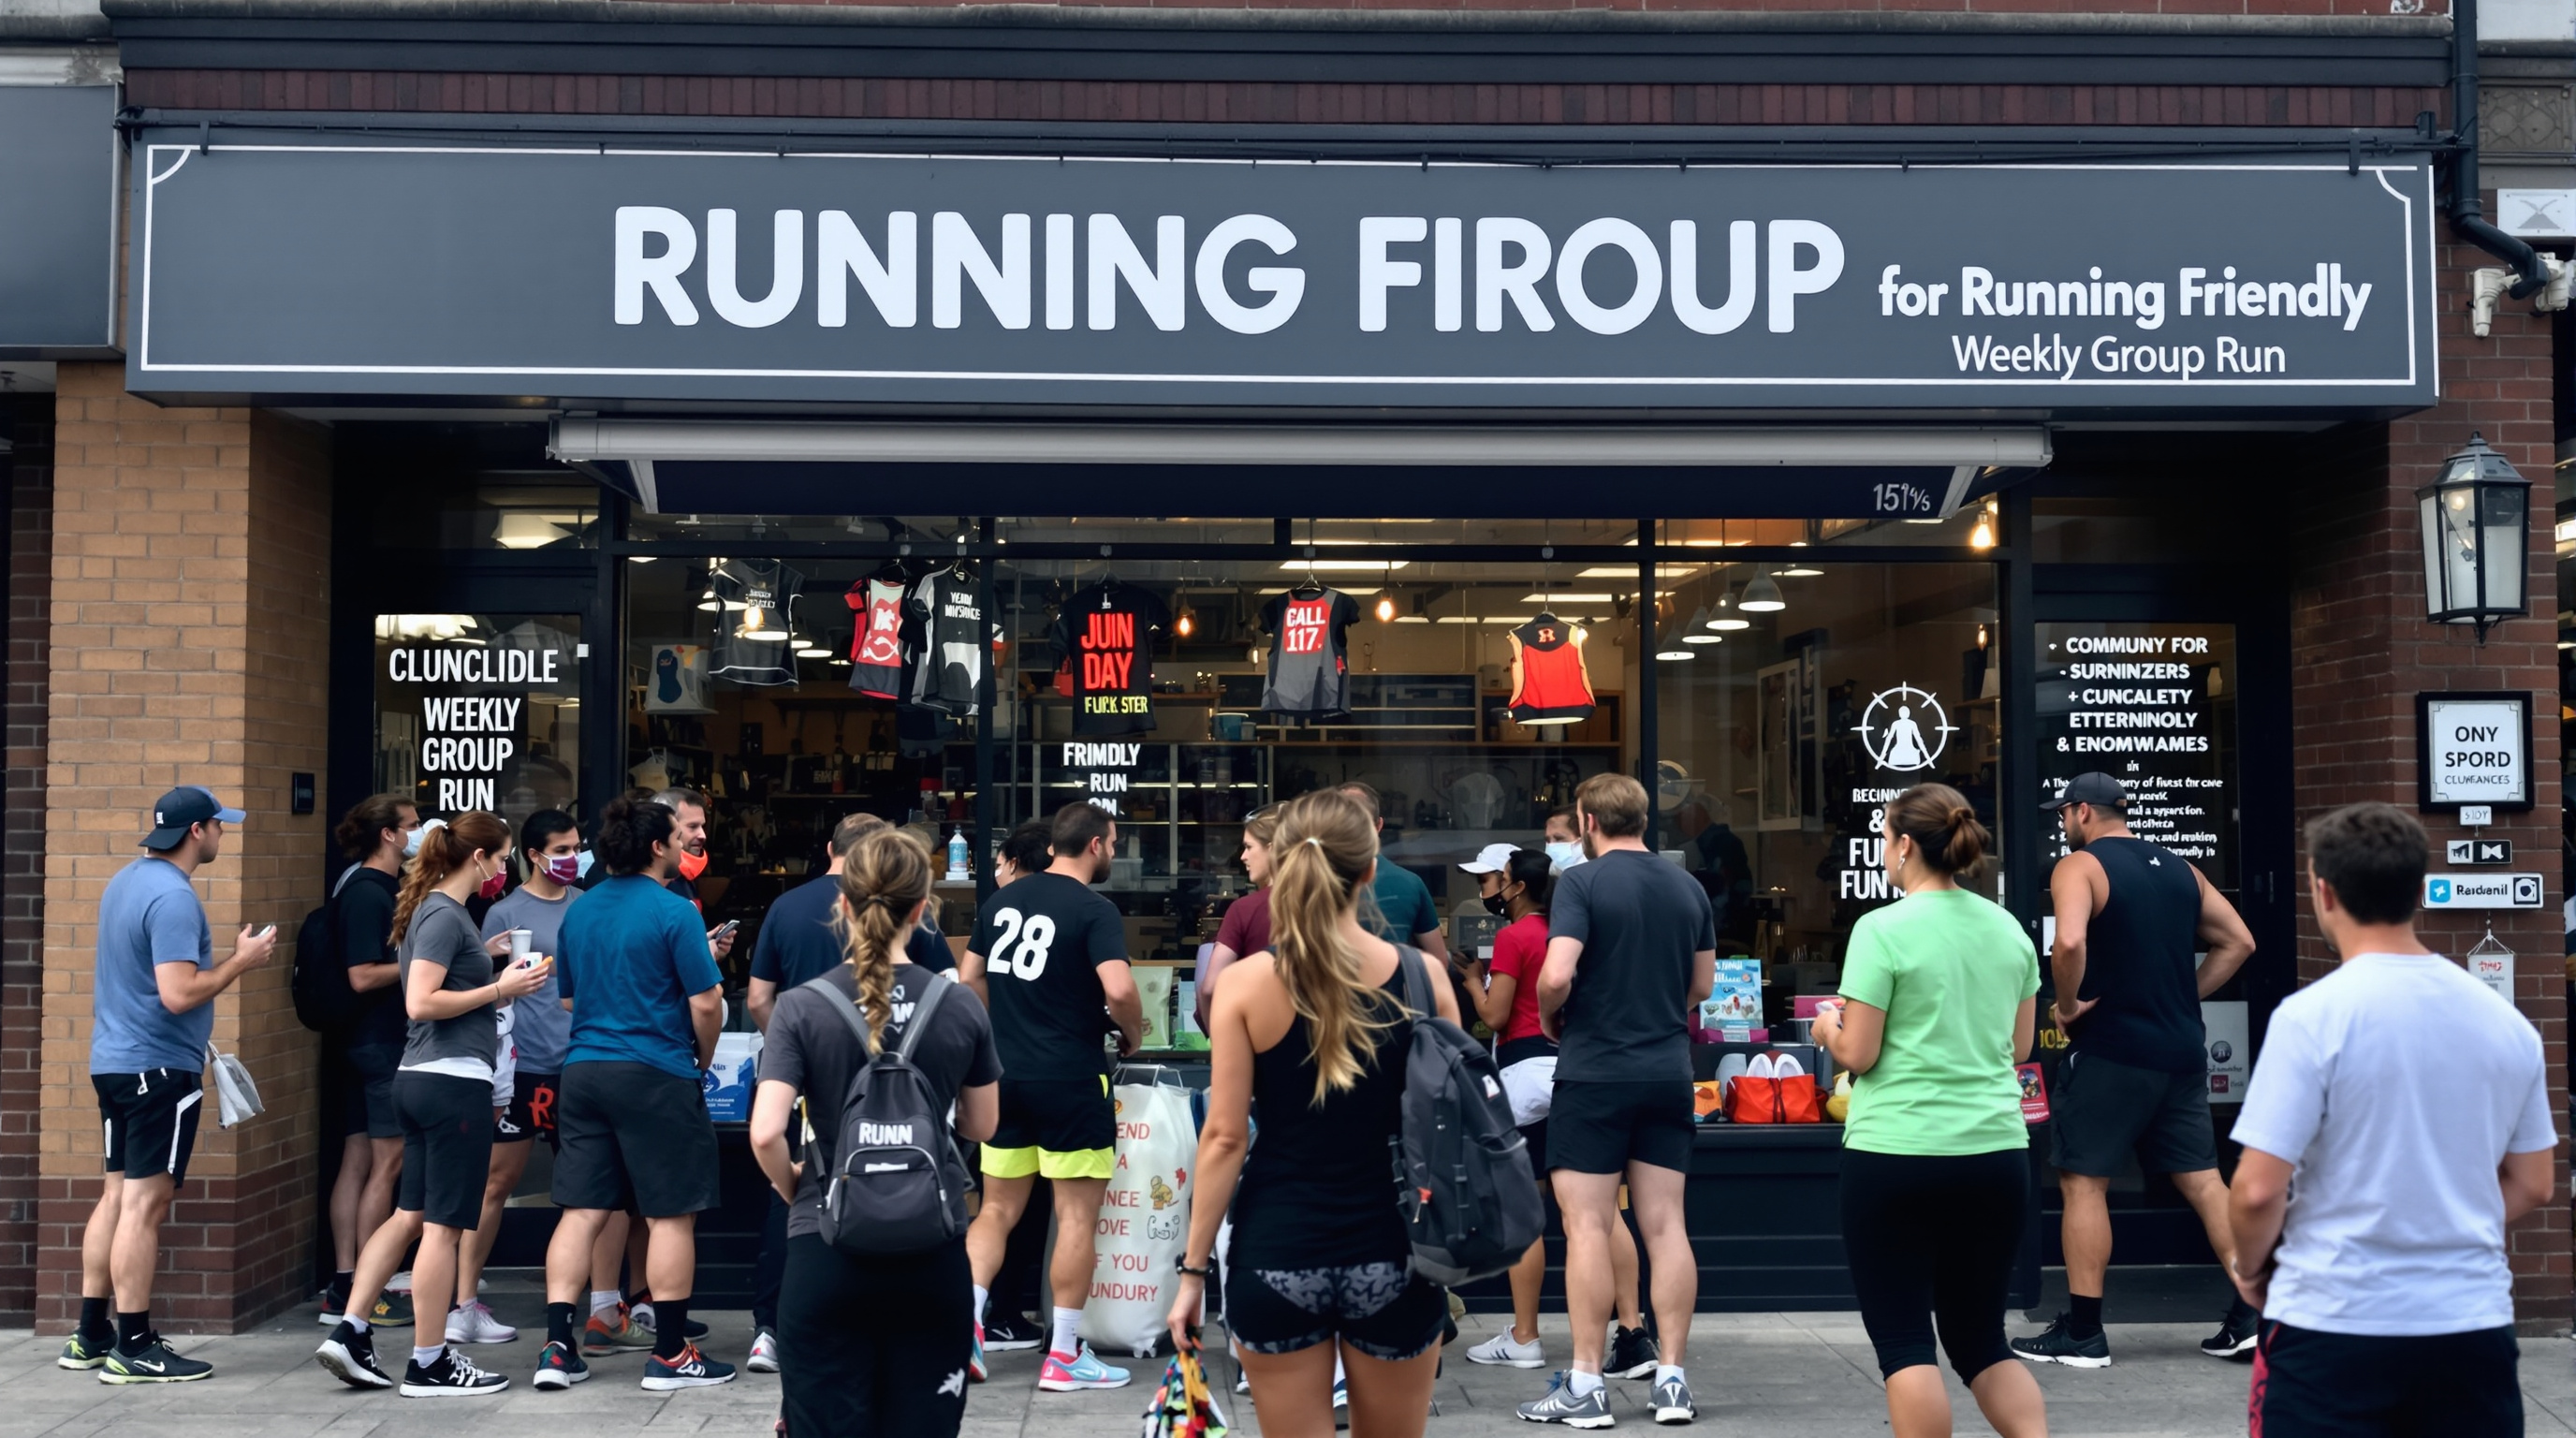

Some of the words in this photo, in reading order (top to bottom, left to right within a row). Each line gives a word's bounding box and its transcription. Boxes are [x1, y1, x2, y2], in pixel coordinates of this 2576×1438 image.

[614, 205, 1306, 335] RUNNING
[1359, 216, 1846, 335] FIROUP
[1878, 264, 1949, 317] for
[1961, 266, 2165, 330] Running
[2179, 262, 2373, 331] Friendly
[1952, 332, 2082, 381] Weekly
[2090, 335, 2205, 381] Group
[2217, 335, 2286, 373] Run
[2066, 637, 2167, 653] COMMUNY
[2171, 637, 2208, 653] FOR
[389, 648, 559, 683] CLUNCLIDLE
[1084, 652, 1134, 689] DAY
[2070, 663, 2190, 680] SURNINZERS
[2082, 688, 2193, 705] CUNCALETY
[423, 697, 521, 732] WEEKLY
[2070, 712, 2199, 728] ETTERNINOLY
[2056, 737, 2071, 752] &
[2454, 726, 2499, 742] ONY
[422, 737, 514, 771] GROUP
[1063, 742, 1141, 767] FRIMDLY
[2444, 751, 2511, 768] SPORD
[439, 778, 494, 812] RUN
[1090, 772, 1128, 793] RUN
[1868, 808, 1885, 833] &
[1840, 870, 1889, 900] FUN
[987, 906, 1057, 981] 28
[858, 1122, 914, 1146] RUNN
[1116, 1122, 1150, 1140] END
[1111, 1253, 1149, 1272] YOU
